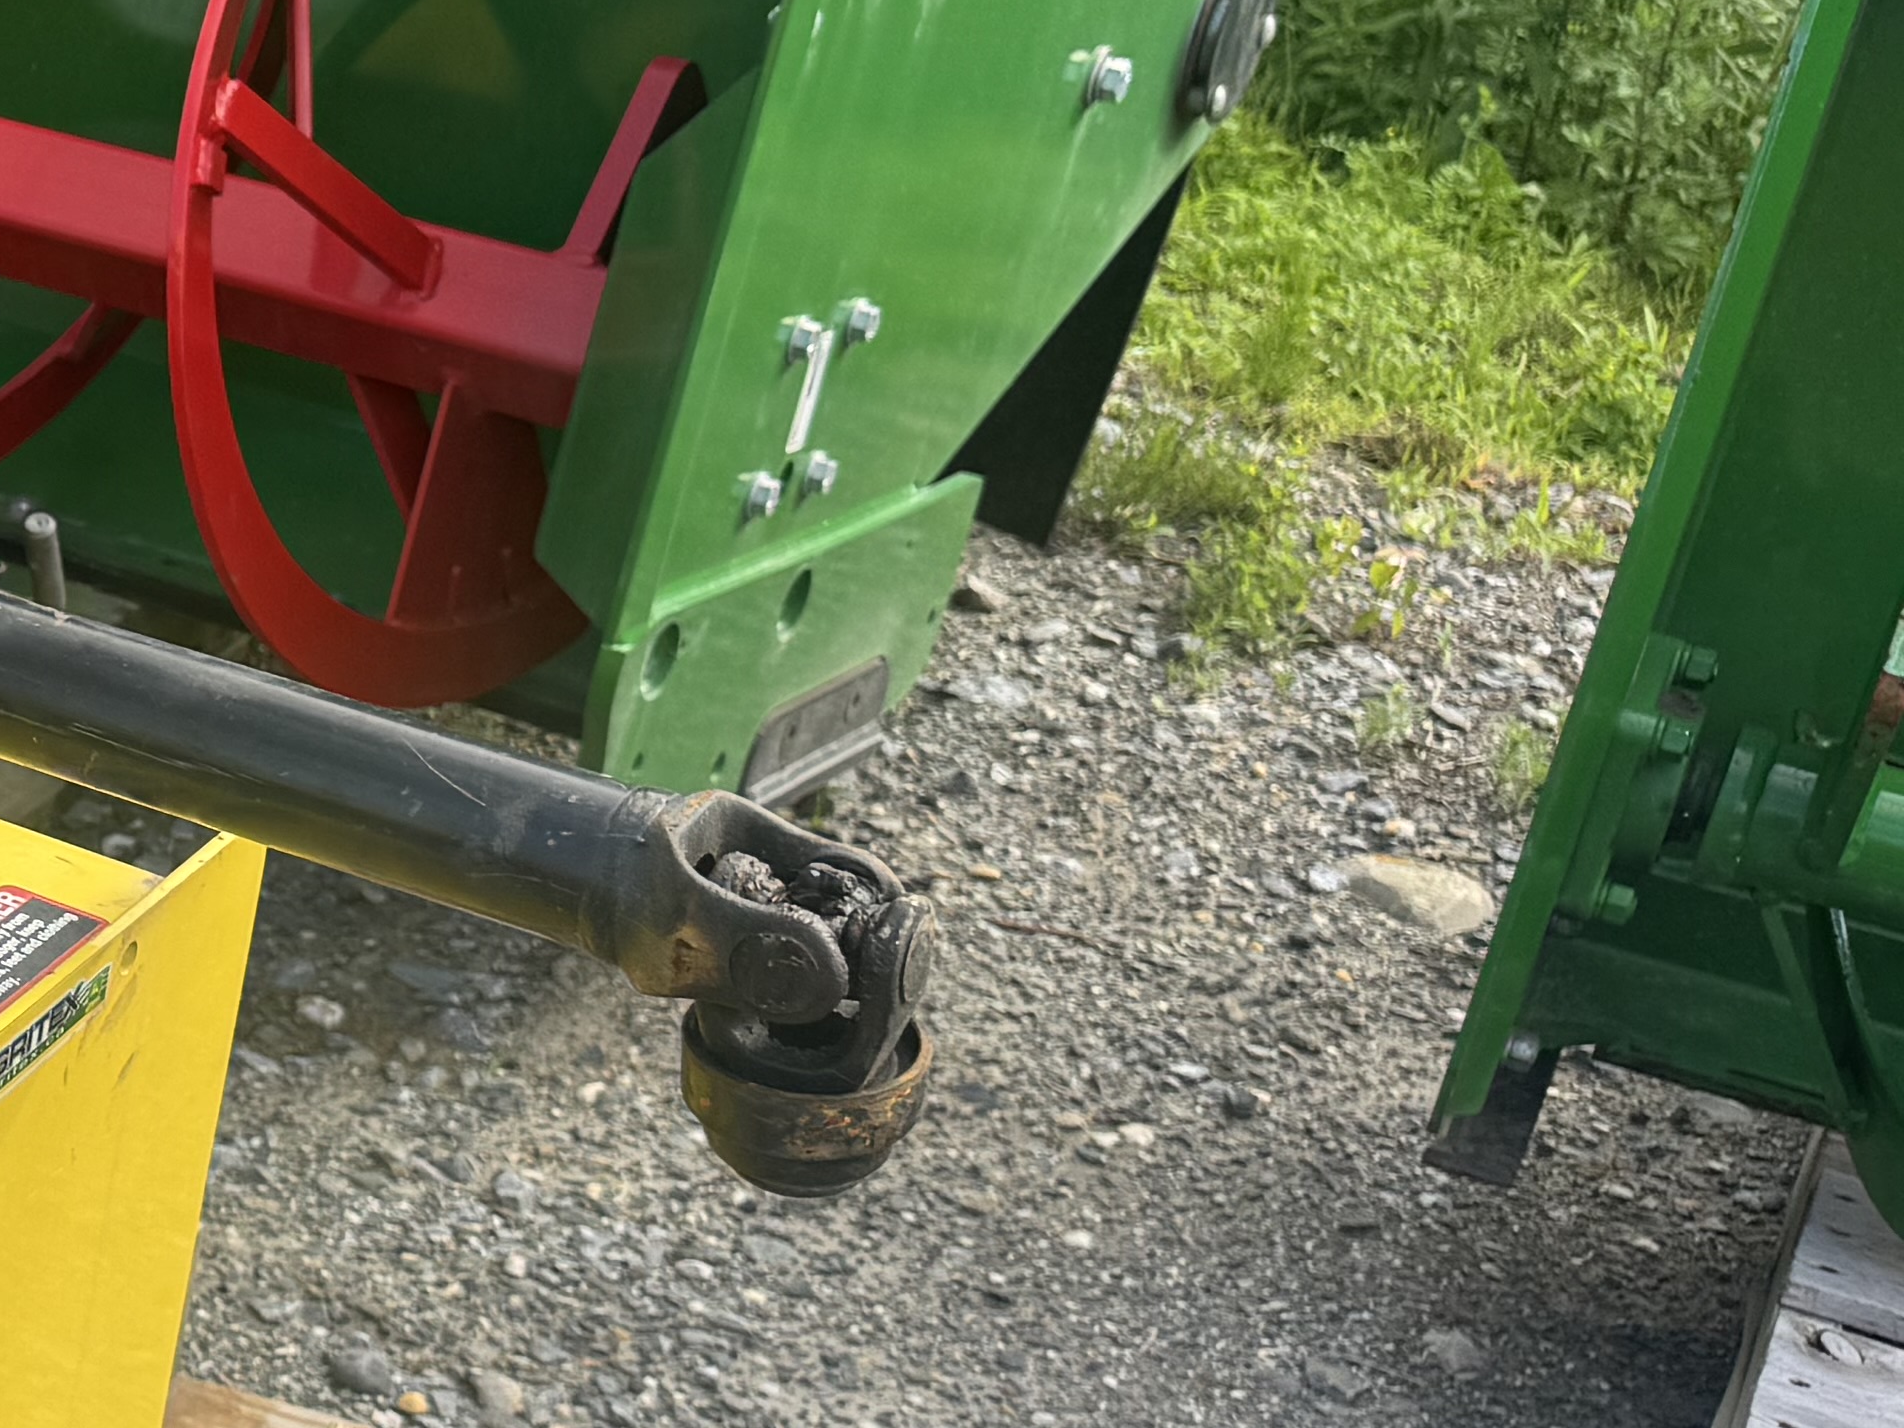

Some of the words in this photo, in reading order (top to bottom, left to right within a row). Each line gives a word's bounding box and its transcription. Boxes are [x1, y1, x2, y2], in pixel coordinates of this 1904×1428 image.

[1, 912, 30, 931] from
[16, 919, 46, 938] keep
[21, 937, 43, 955] and
[37, 912, 80, 941] clothing
